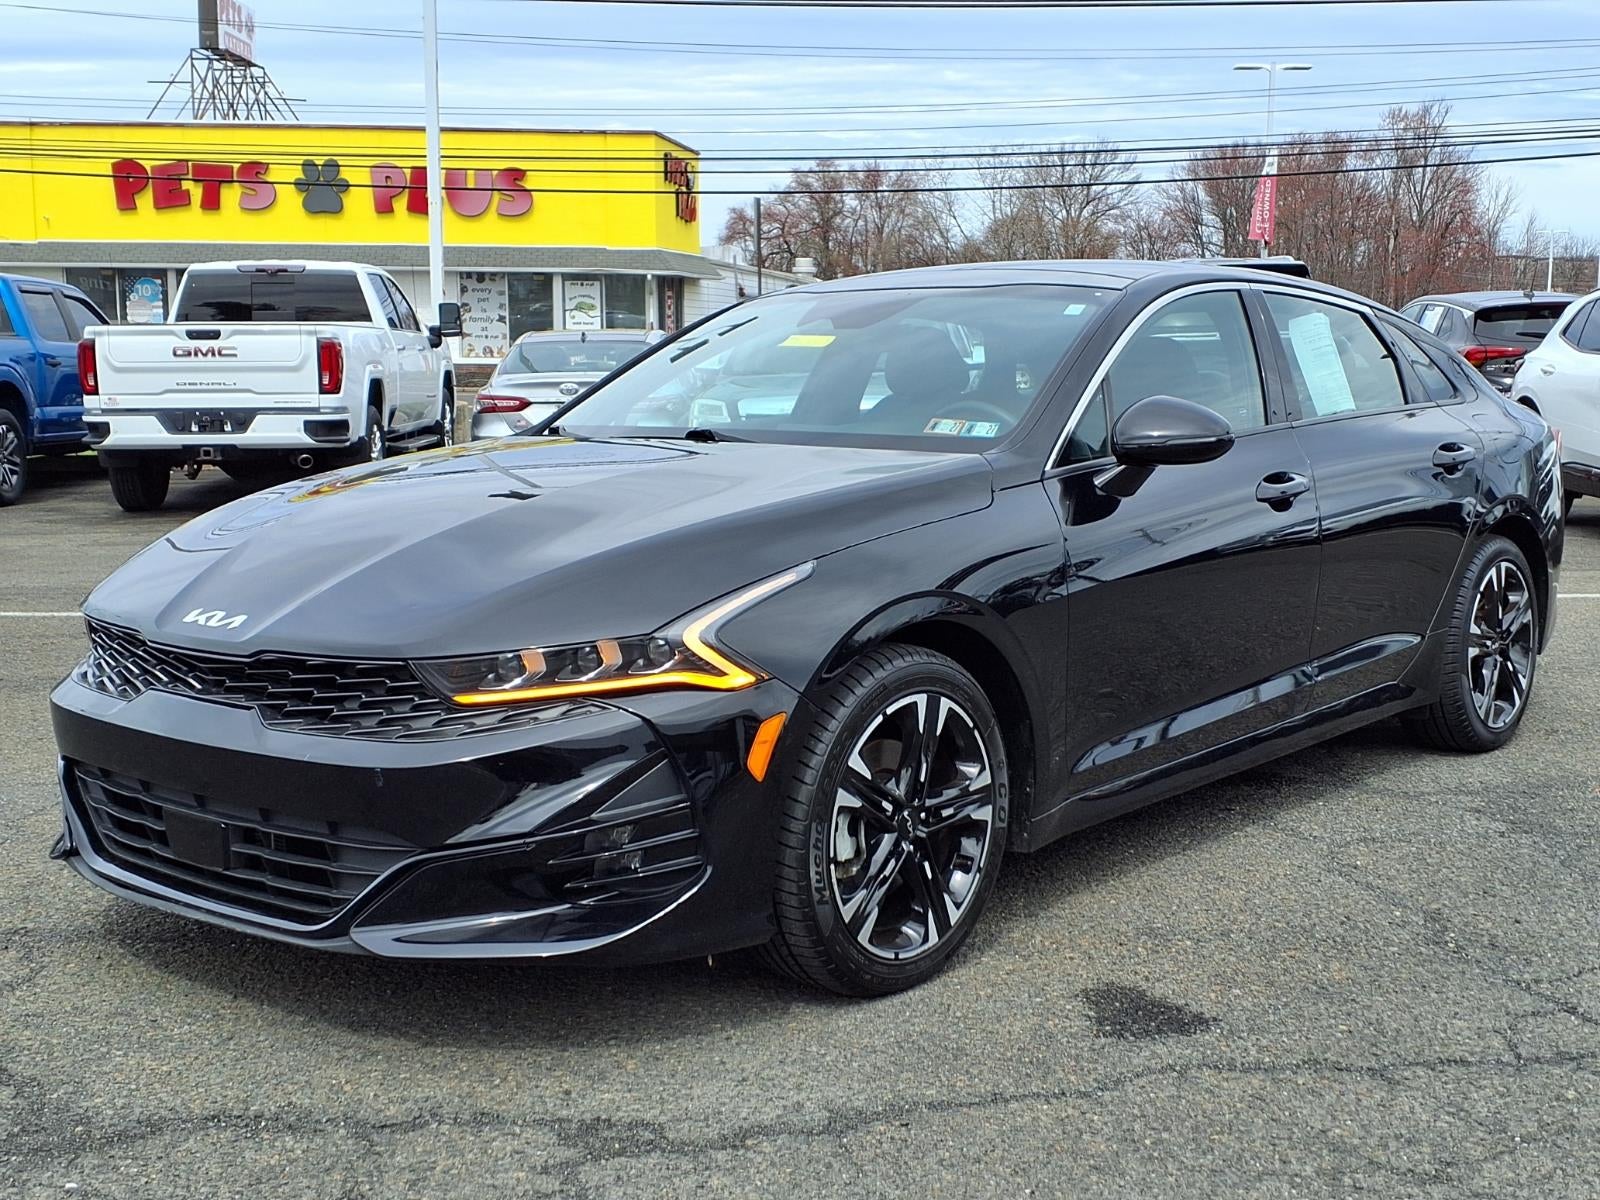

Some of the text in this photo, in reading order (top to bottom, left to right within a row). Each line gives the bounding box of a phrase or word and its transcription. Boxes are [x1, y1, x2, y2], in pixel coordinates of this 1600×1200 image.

[111, 158, 277, 211] PETS
[471, 287, 493, 296] every
[468, 315, 495, 325] family
[172, 346, 238, 358] GMC
